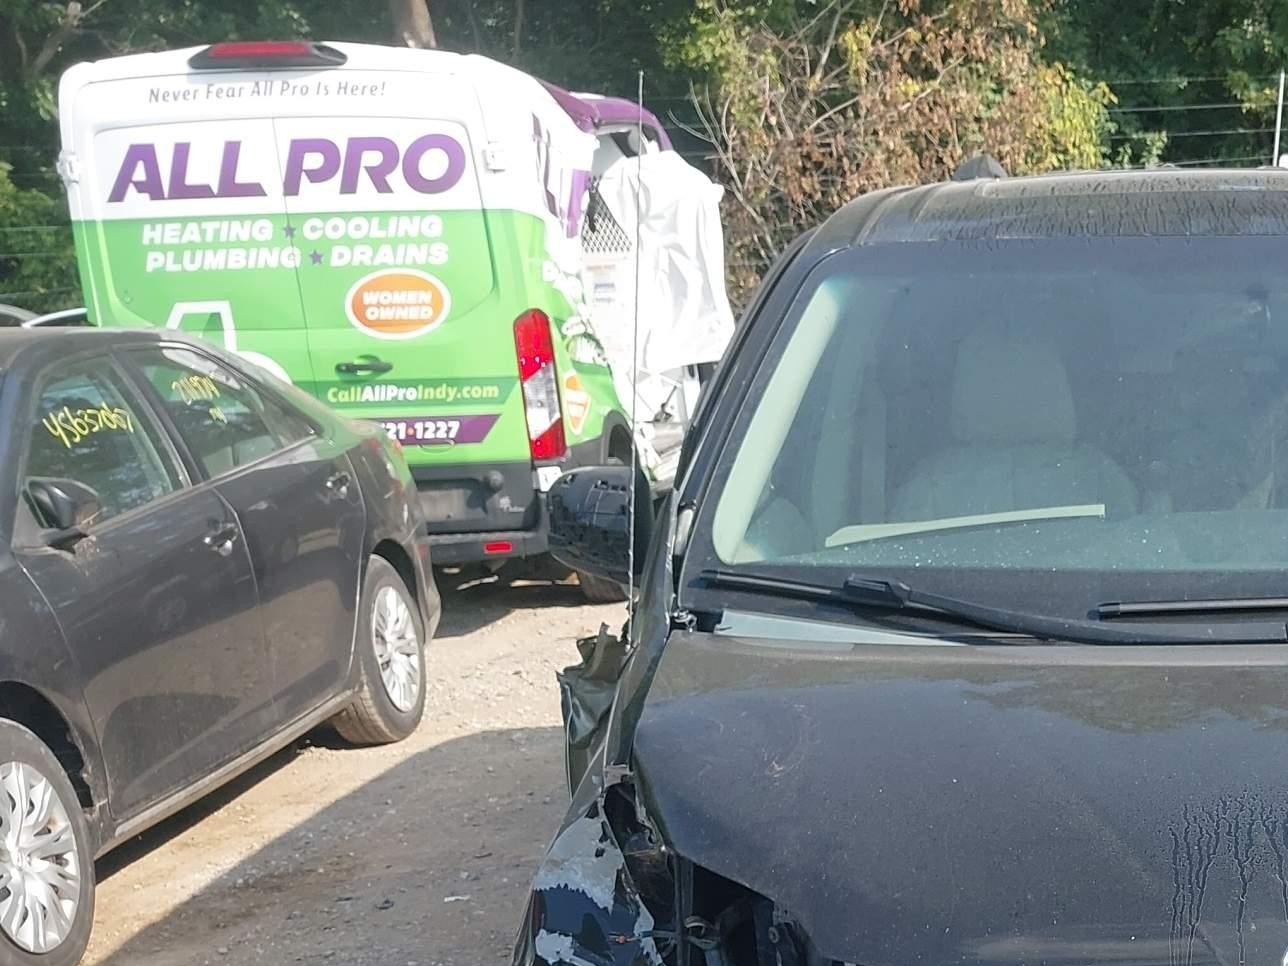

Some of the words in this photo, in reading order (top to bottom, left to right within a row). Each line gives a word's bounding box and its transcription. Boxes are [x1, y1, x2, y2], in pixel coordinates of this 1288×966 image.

[148, 87, 199, 103] Never
[206, 83, 245, 99] Fear
[251, 80, 274, 97] All
[280, 81, 309, 96] Pro
[316, 81, 330, 96] Is
[336, 81, 386, 97] Here!
[107, 140, 268, 203] ALL
[283, 133, 466, 196] PRO
[142, 219, 273, 245] HEATING
[302, 215, 444, 240] COOLING
[145, 245, 301, 272] PLUMBING
[330, 243, 449, 267] DRAINS
[362, 290, 433, 305] WOMEN
[365, 306, 433, 321] OWNED
[327, 384, 499, 402] CallAllProIndy.com
